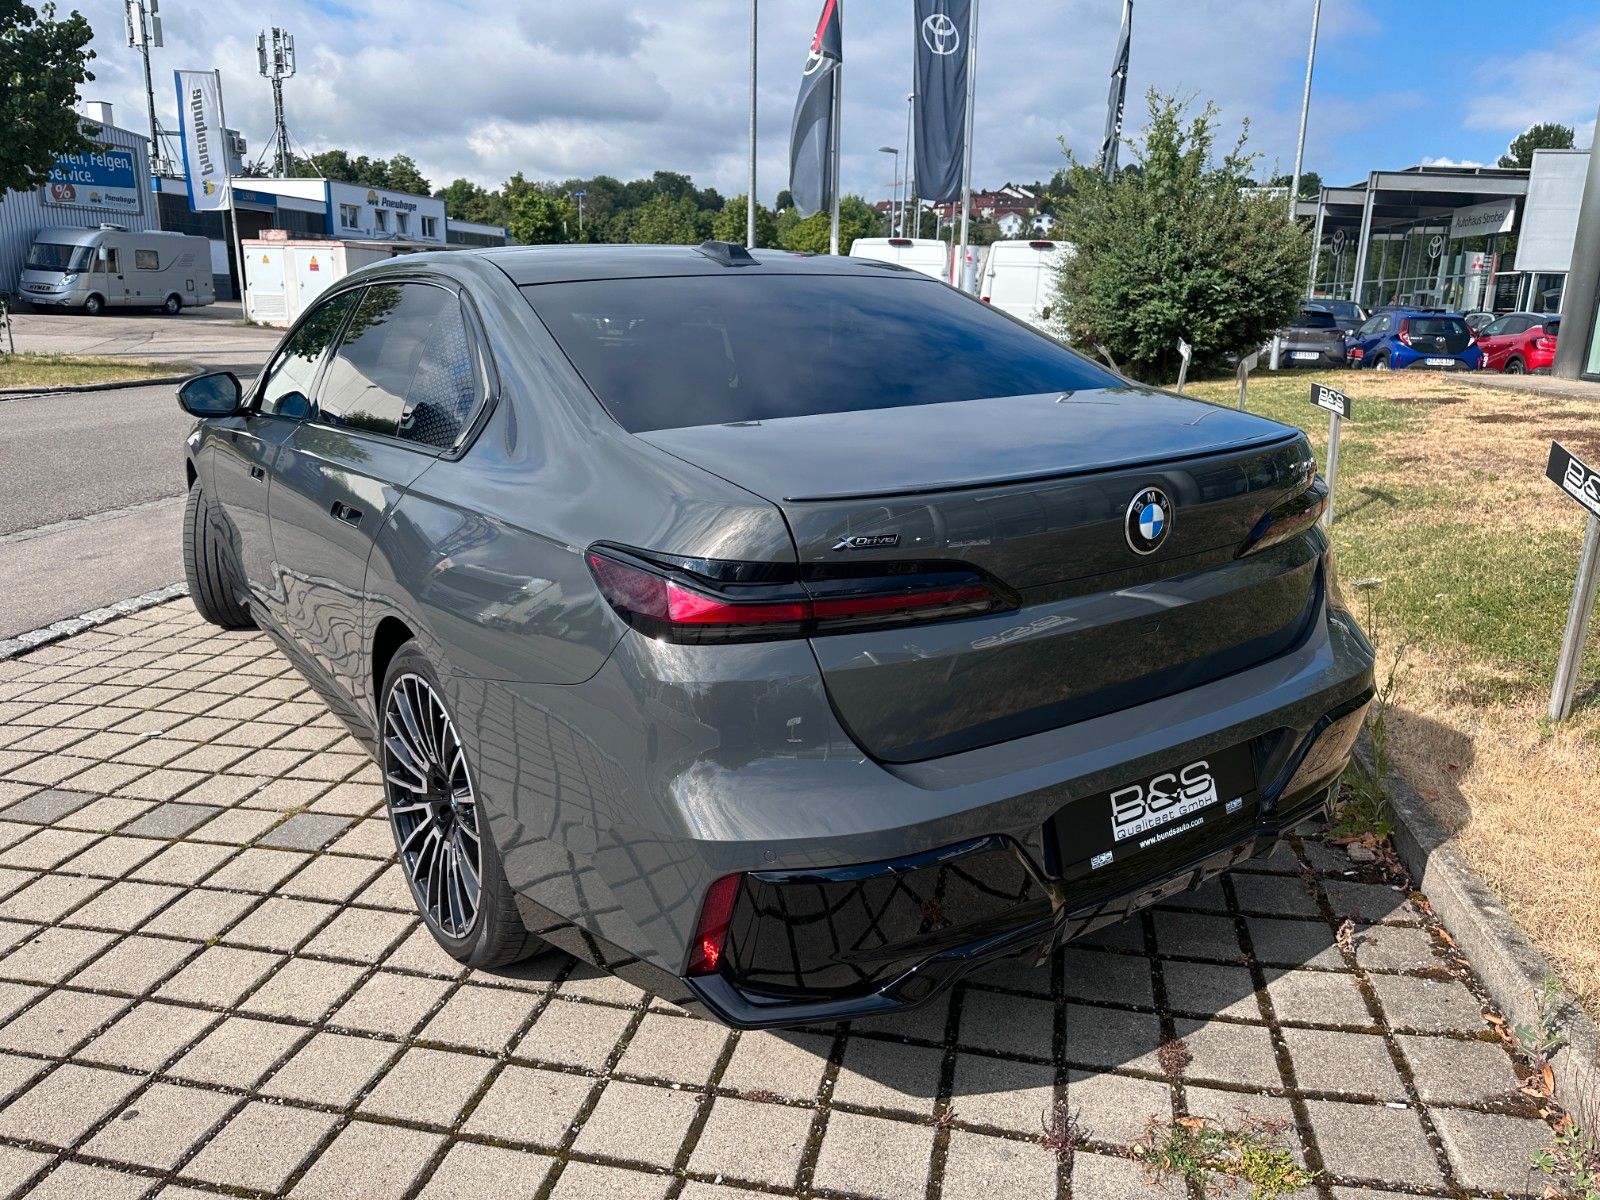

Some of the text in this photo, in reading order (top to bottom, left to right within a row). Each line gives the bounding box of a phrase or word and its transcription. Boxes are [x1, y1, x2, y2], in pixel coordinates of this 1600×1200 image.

[90, 152, 132, 172] Felgen,
[381, 197, 417, 212] Pneuhage
[1319, 387, 1344, 409] B&S
[1566, 457, 1600, 504] B&
[1133, 491, 1168, 514] BMW
[1110, 760, 1213, 827] B&S
[1116, 795, 1213, 840] Qualitaet GmbH
[1139, 816, 1204, 849] www.bundsauto.com
